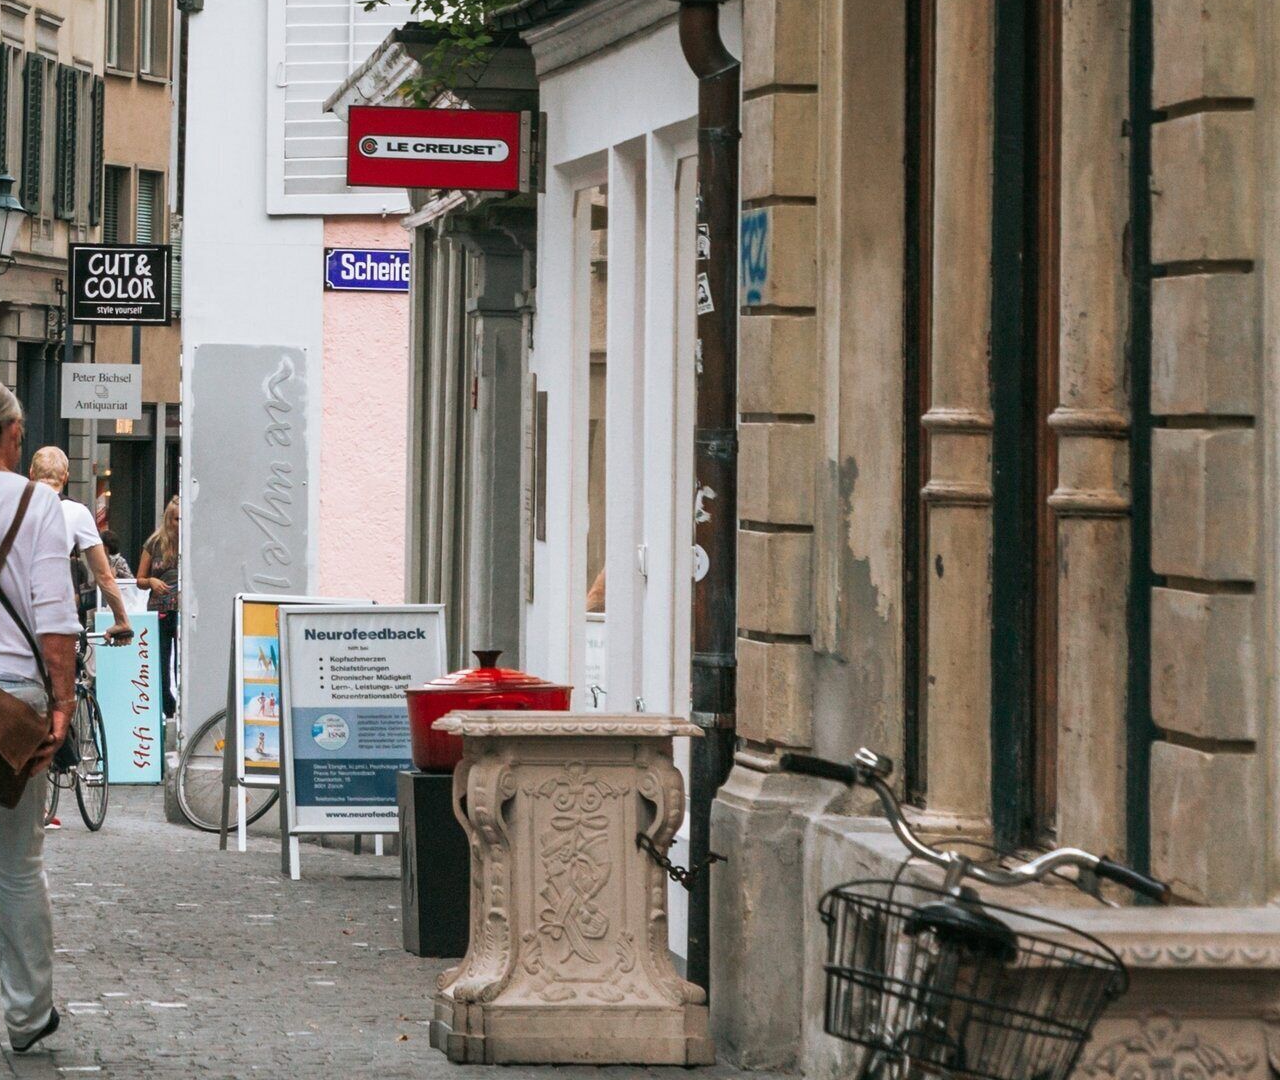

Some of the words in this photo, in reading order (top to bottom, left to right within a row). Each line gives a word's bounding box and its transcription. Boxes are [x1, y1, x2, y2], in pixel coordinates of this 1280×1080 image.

[386, 142, 408, 152] LE
[412, 143, 496, 155] CREUSET
[84, 277, 156, 299] COLOR
[97, 306, 114, 314] style
[115, 306, 142, 315] yourself
[72, 373, 96, 383] Peter
[99, 373, 132, 383] Bichsel
[75, 400, 128, 412] Antiquariat
[304, 628, 426, 640] Neurofeedback
